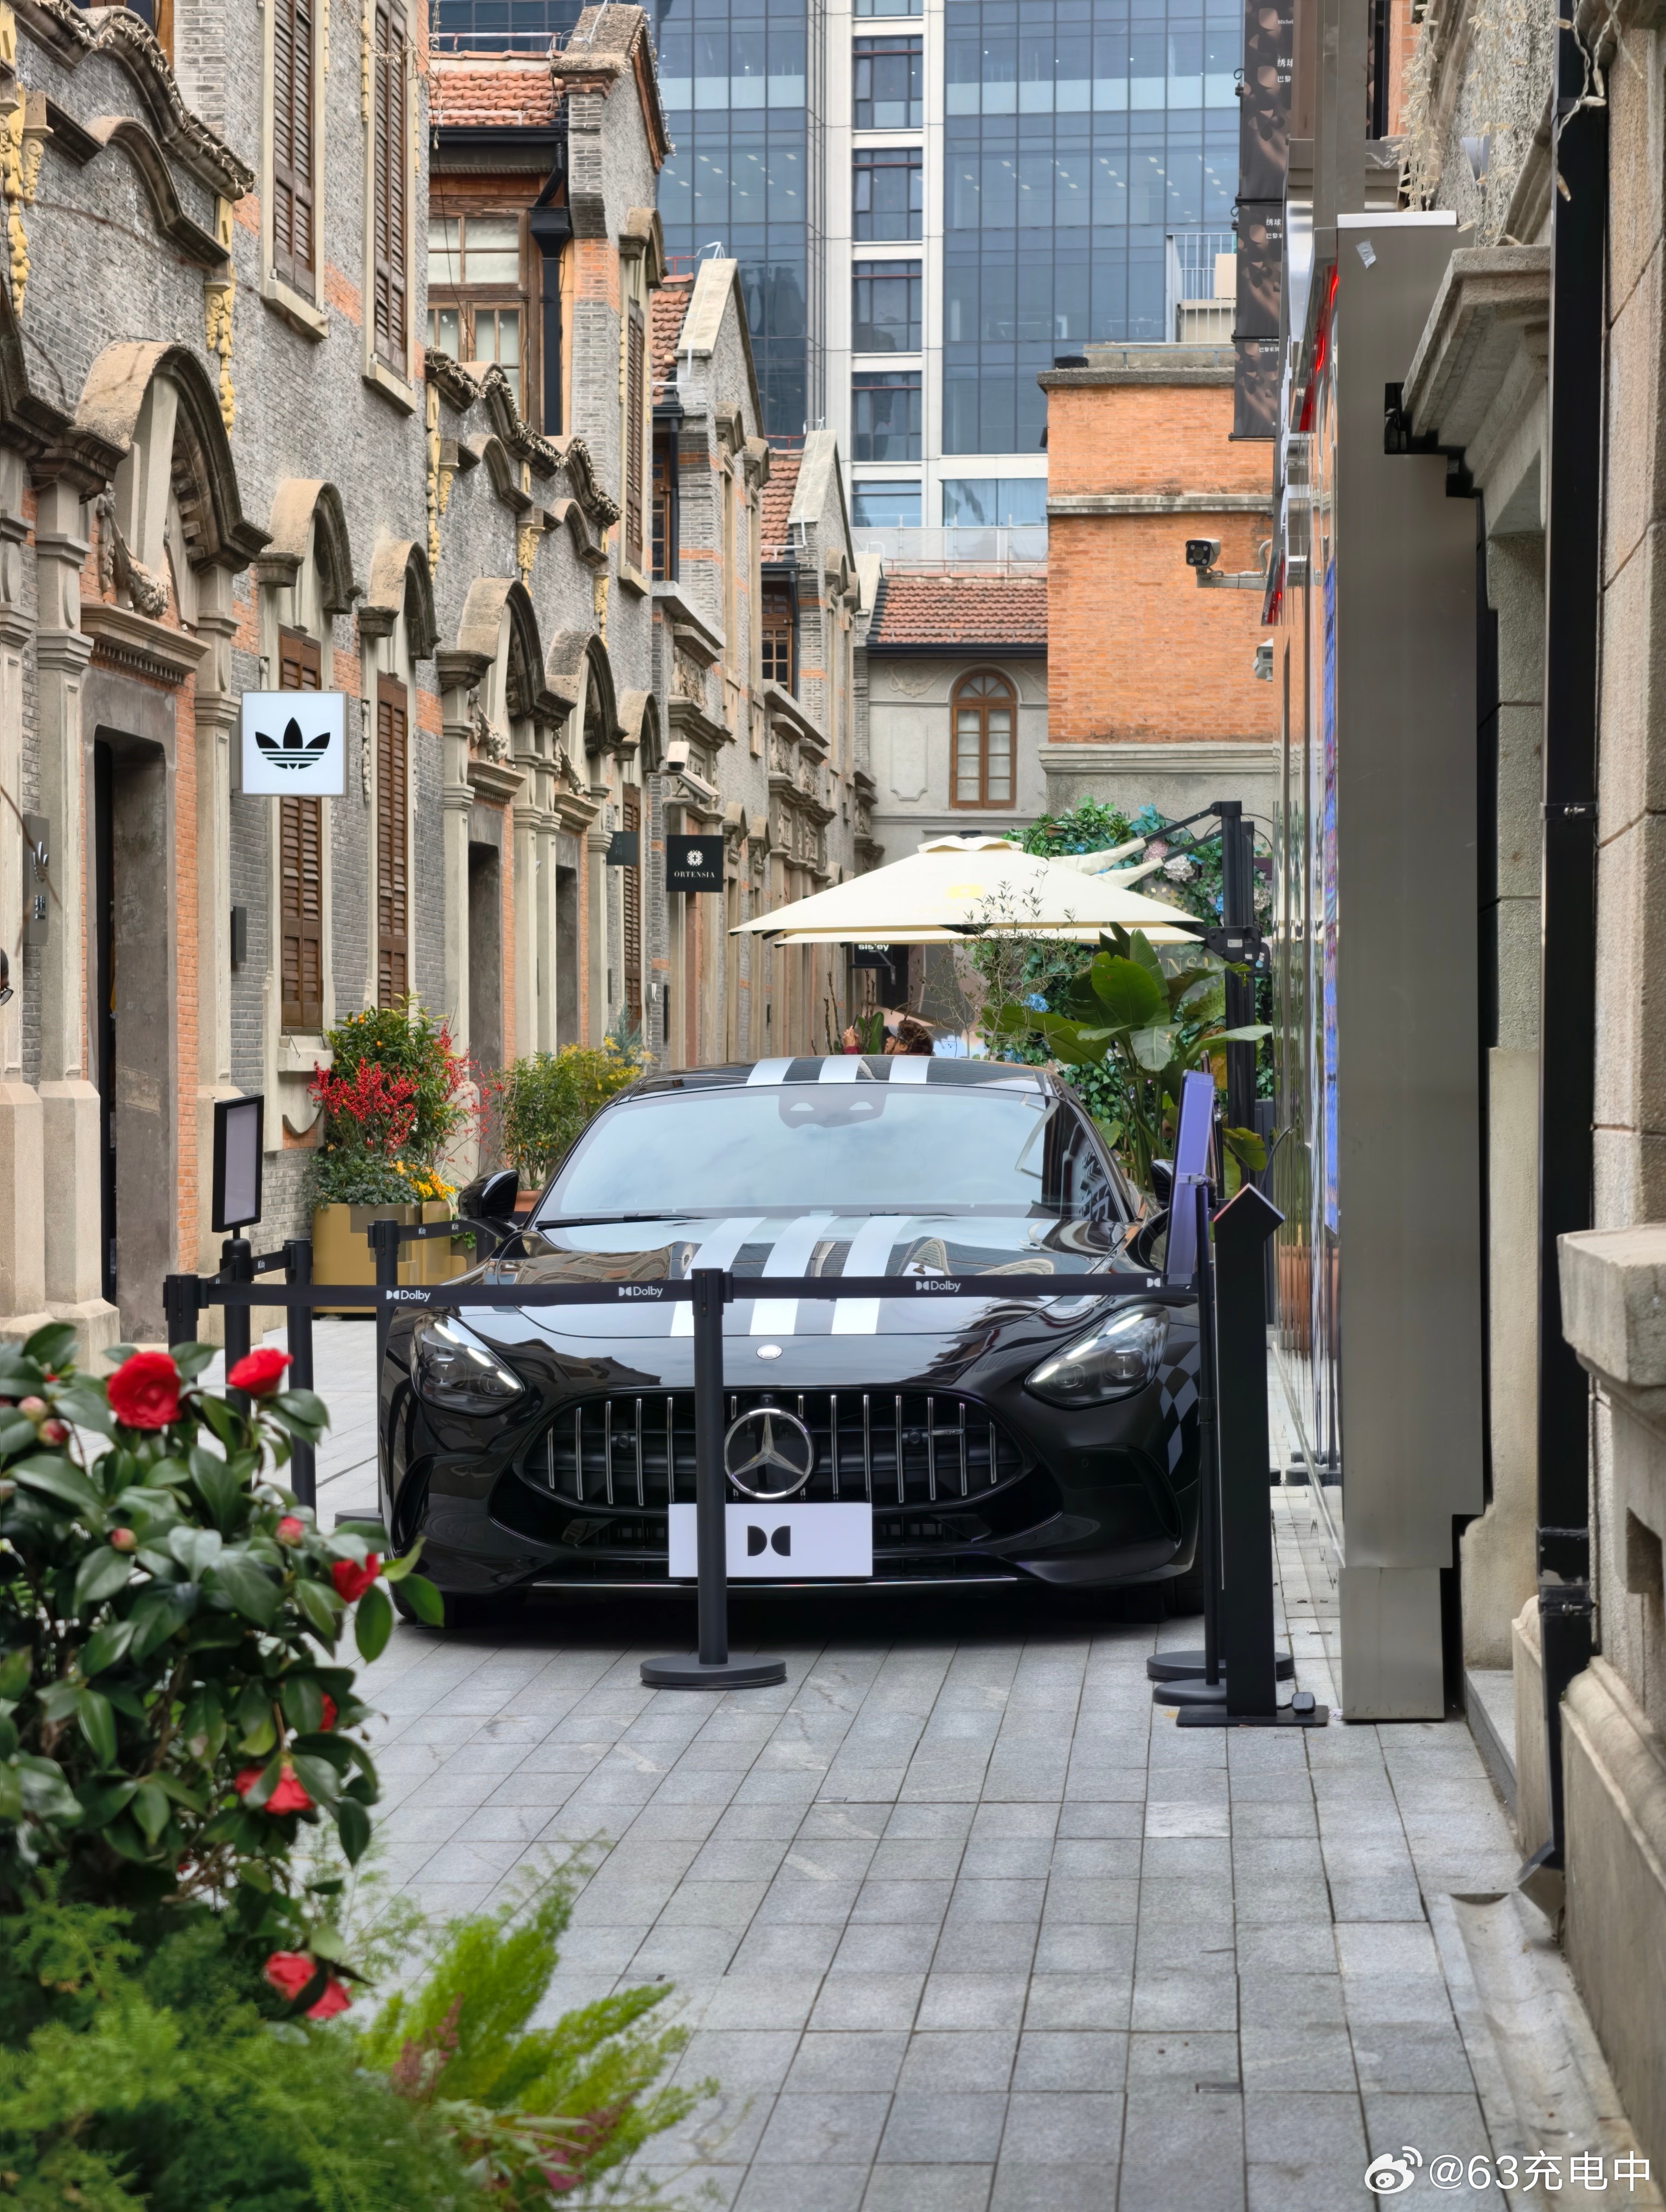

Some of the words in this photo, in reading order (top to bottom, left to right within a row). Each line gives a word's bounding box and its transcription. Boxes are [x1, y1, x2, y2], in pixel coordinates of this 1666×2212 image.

[858, 943, 889, 951] sisey
[633, 1286, 663, 1297] Dolby
[931, 1281, 961, 1293] Dolby
[401, 1290, 431, 1302] Dolby
